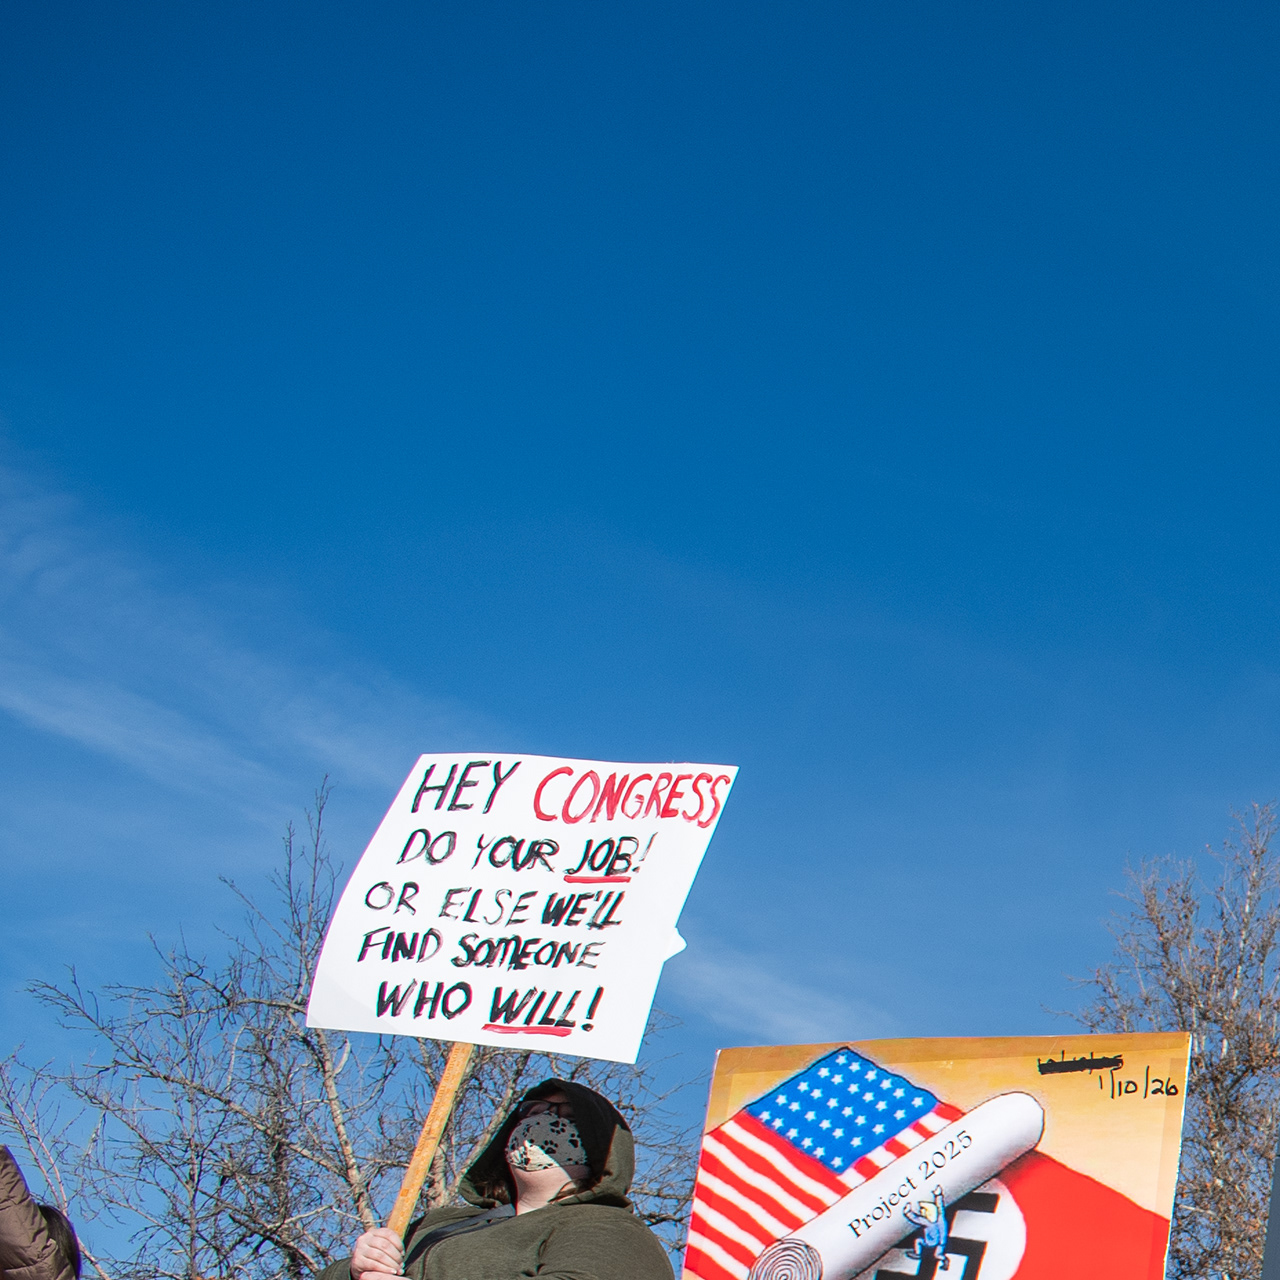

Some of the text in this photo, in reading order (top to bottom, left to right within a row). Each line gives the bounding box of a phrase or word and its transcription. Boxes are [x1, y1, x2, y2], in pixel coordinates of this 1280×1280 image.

[411, 760, 731, 829] HEY CONGRESS
[396, 828, 658, 878] DO YOUR JOB!
[364, 881, 625, 930] OR ELSE WE'LL
[357, 927, 606, 971] FIND SOMEONE
[376, 978, 604, 1031] WHO WILL!
[848, 1130, 973, 1240] Project 2025
